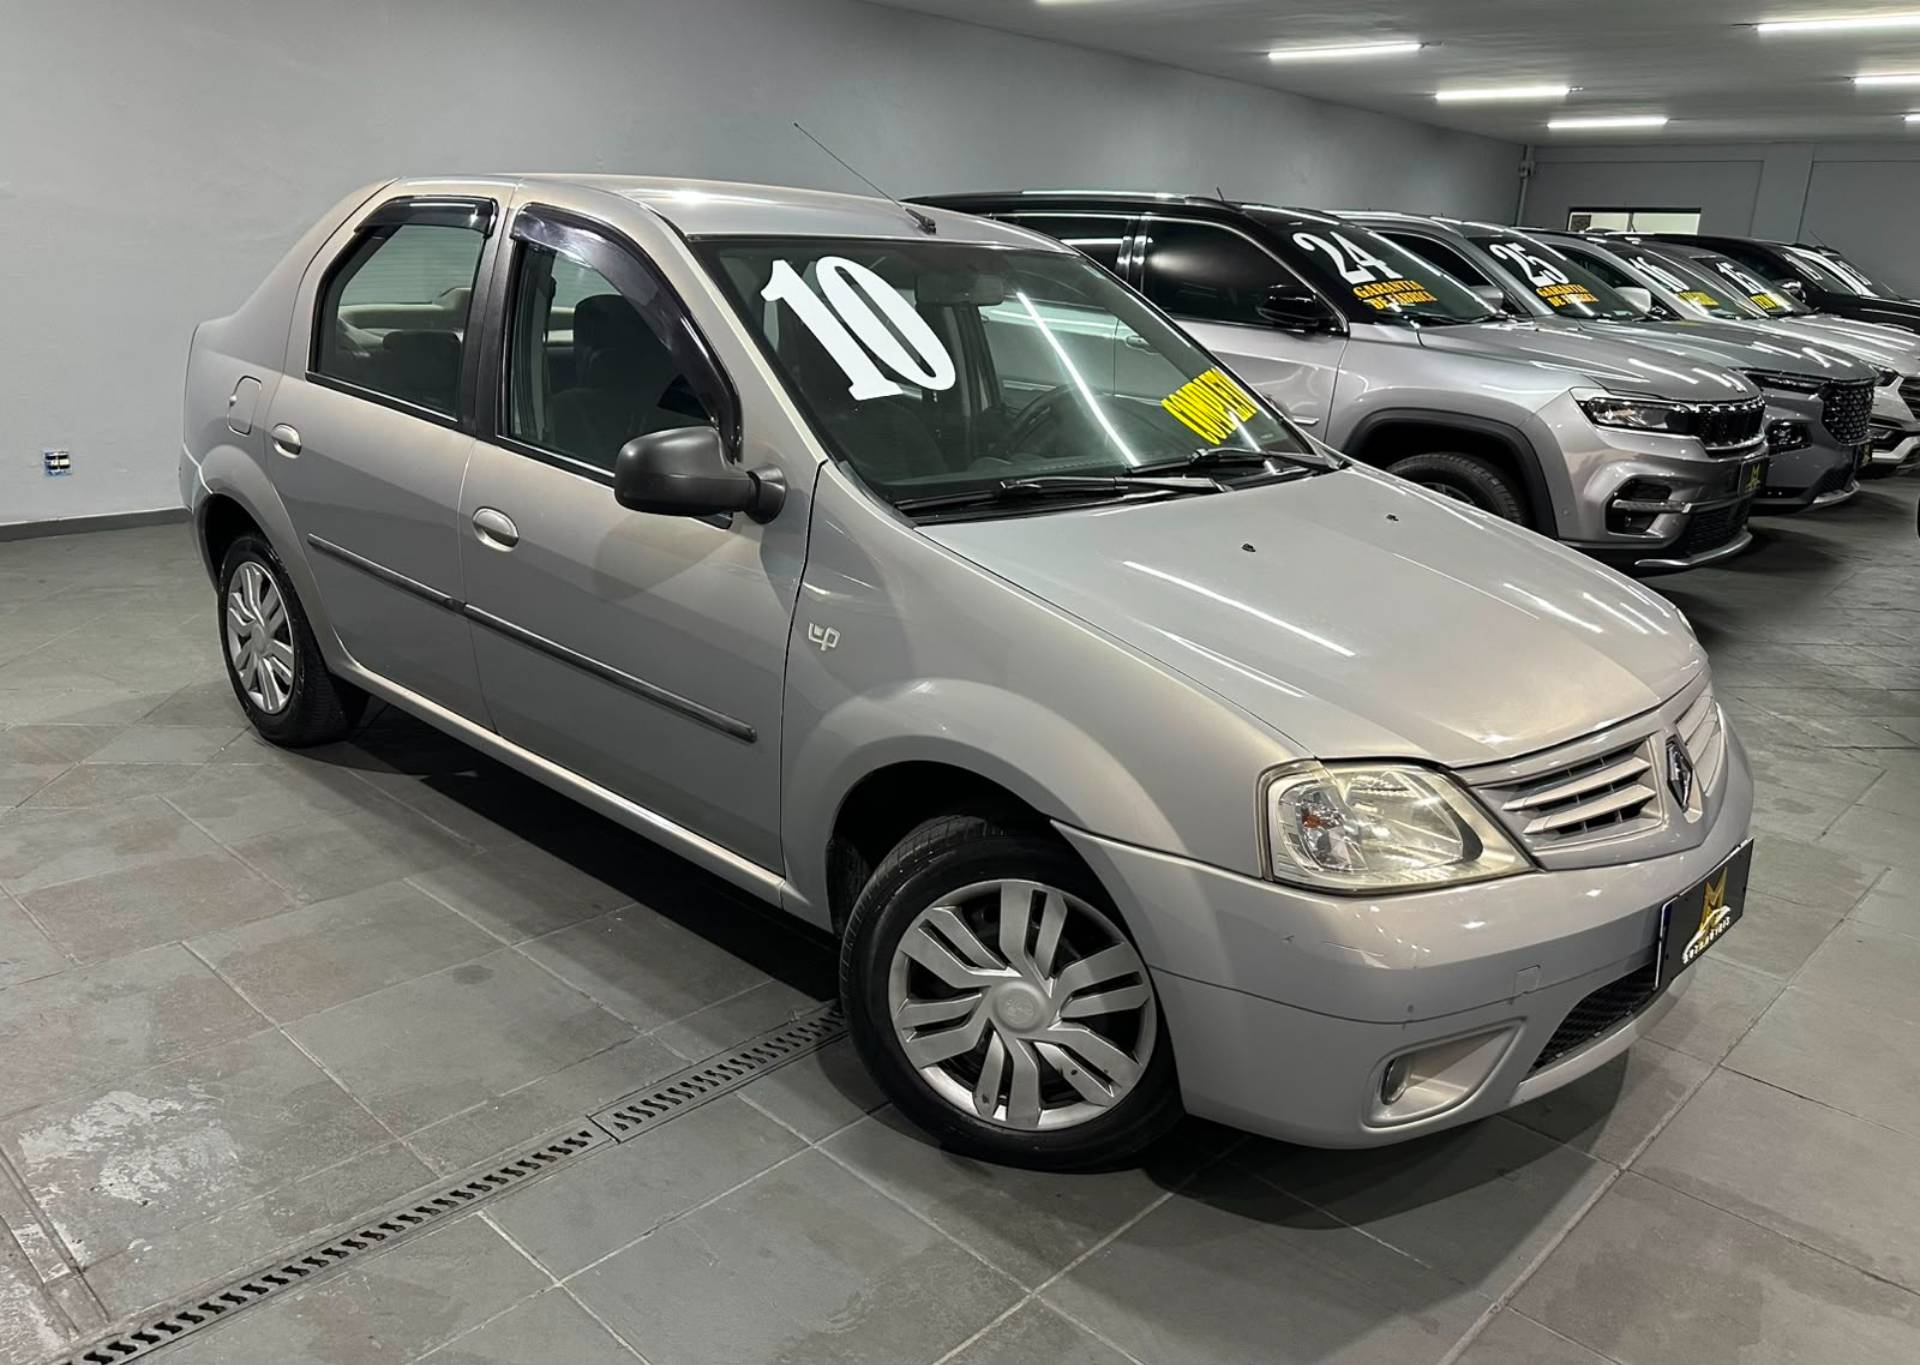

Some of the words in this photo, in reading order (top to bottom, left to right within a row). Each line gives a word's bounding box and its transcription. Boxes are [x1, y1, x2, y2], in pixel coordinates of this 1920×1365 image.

[1292, 231, 1404, 285] 24
[1489, 243, 1570, 288] 25
[1352, 280, 1426, 299] GARANTIA
[760, 256, 956, 400] 10
